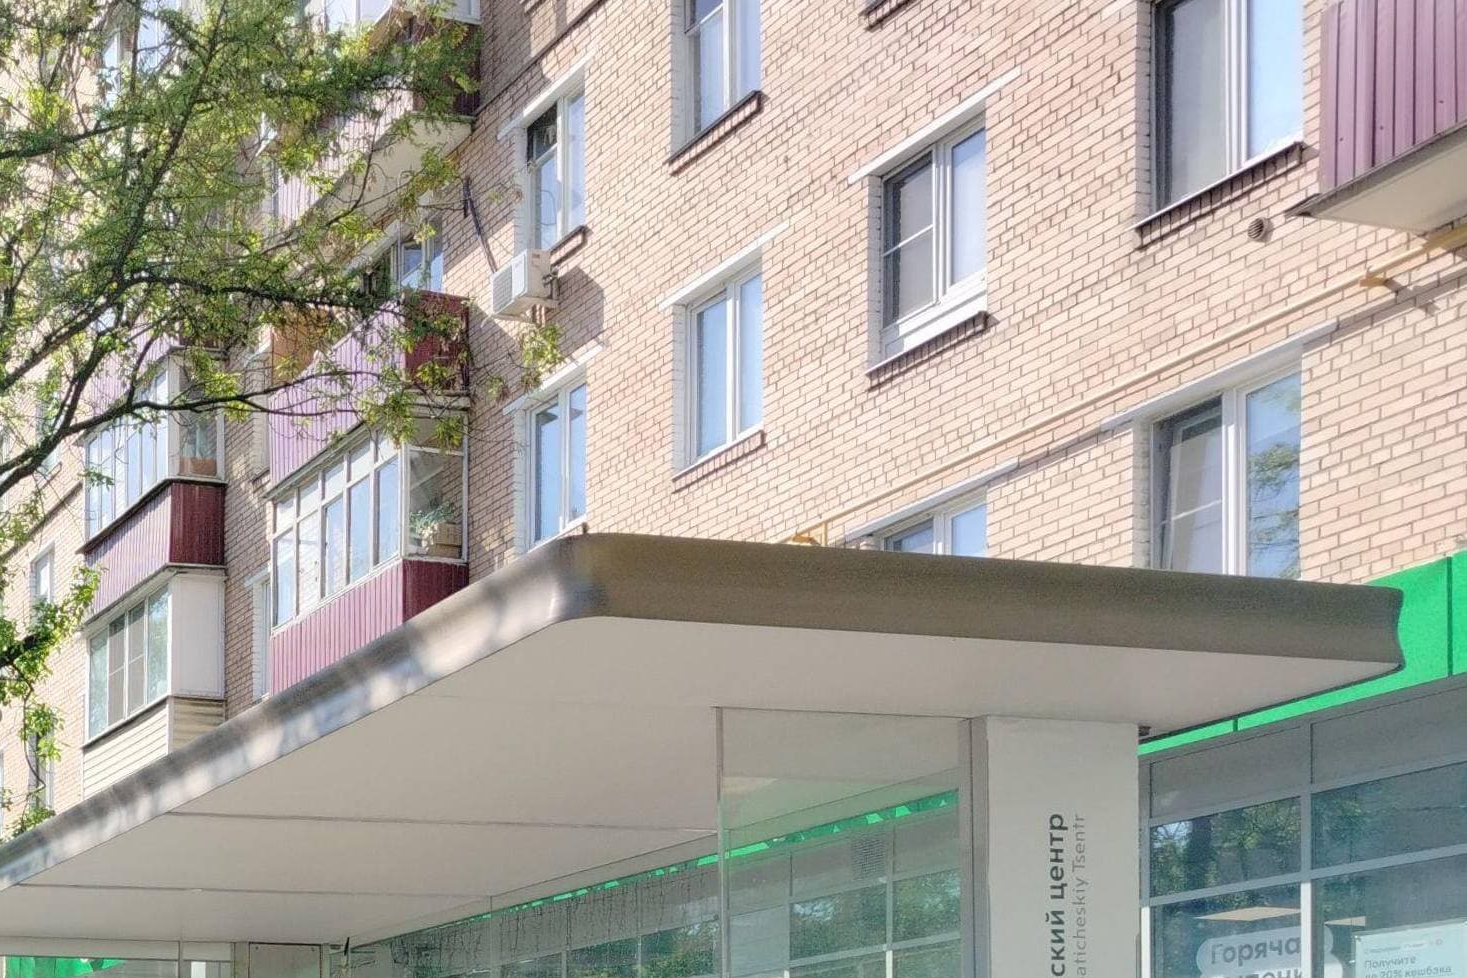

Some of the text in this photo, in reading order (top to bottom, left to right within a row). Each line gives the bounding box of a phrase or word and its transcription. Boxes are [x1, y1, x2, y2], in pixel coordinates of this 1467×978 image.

[1049, 813, 1068, 900] центр
[1072, 813, 1086, 873] Tsentr
[1211, 936, 1302, 967] Горяча
